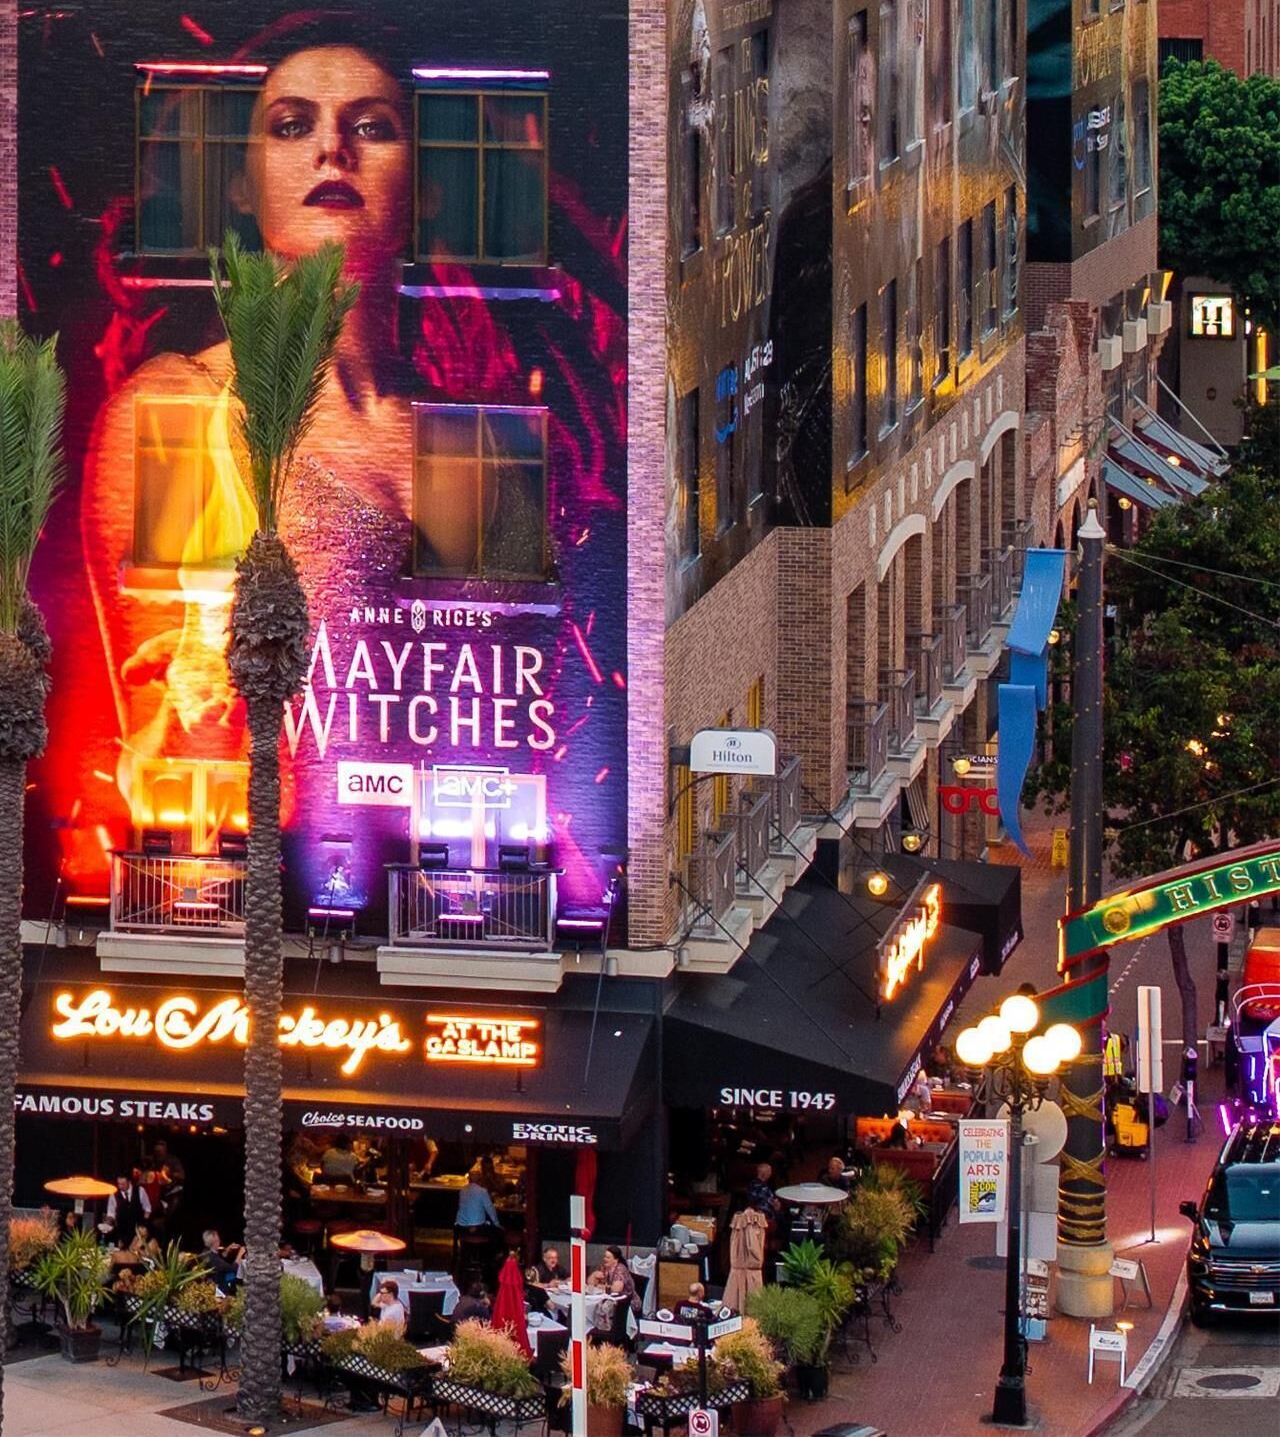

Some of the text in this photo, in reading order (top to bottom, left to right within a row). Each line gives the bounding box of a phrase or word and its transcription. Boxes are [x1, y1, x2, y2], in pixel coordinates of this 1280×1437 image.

[349, 607, 493, 627] ANNE RICE'S
[284, 688, 556, 760] WITCHES
[712, 750, 753, 764] Hilton
[52, 990, 154, 1038] Lou
[442, 1022, 521, 1041] AT THE
[426, 1037, 537, 1059] GASLAMP
[14, 1094, 214, 1121] FAMOUS STEAKS
[720, 1087, 836, 1110] SINCE 1945
[302, 1112, 424, 1130] Choice SEAFOOD
[513, 1123, 591, 1134] EXOTIC
[513, 1132, 597, 1144] DRINKS
[963, 1128, 1004, 1137] CELEBRATING
[975, 1139, 992, 1149] THE
[963, 1151, 1004, 1162] POPULAR
[967, 1164, 1000, 1176] ARTS
